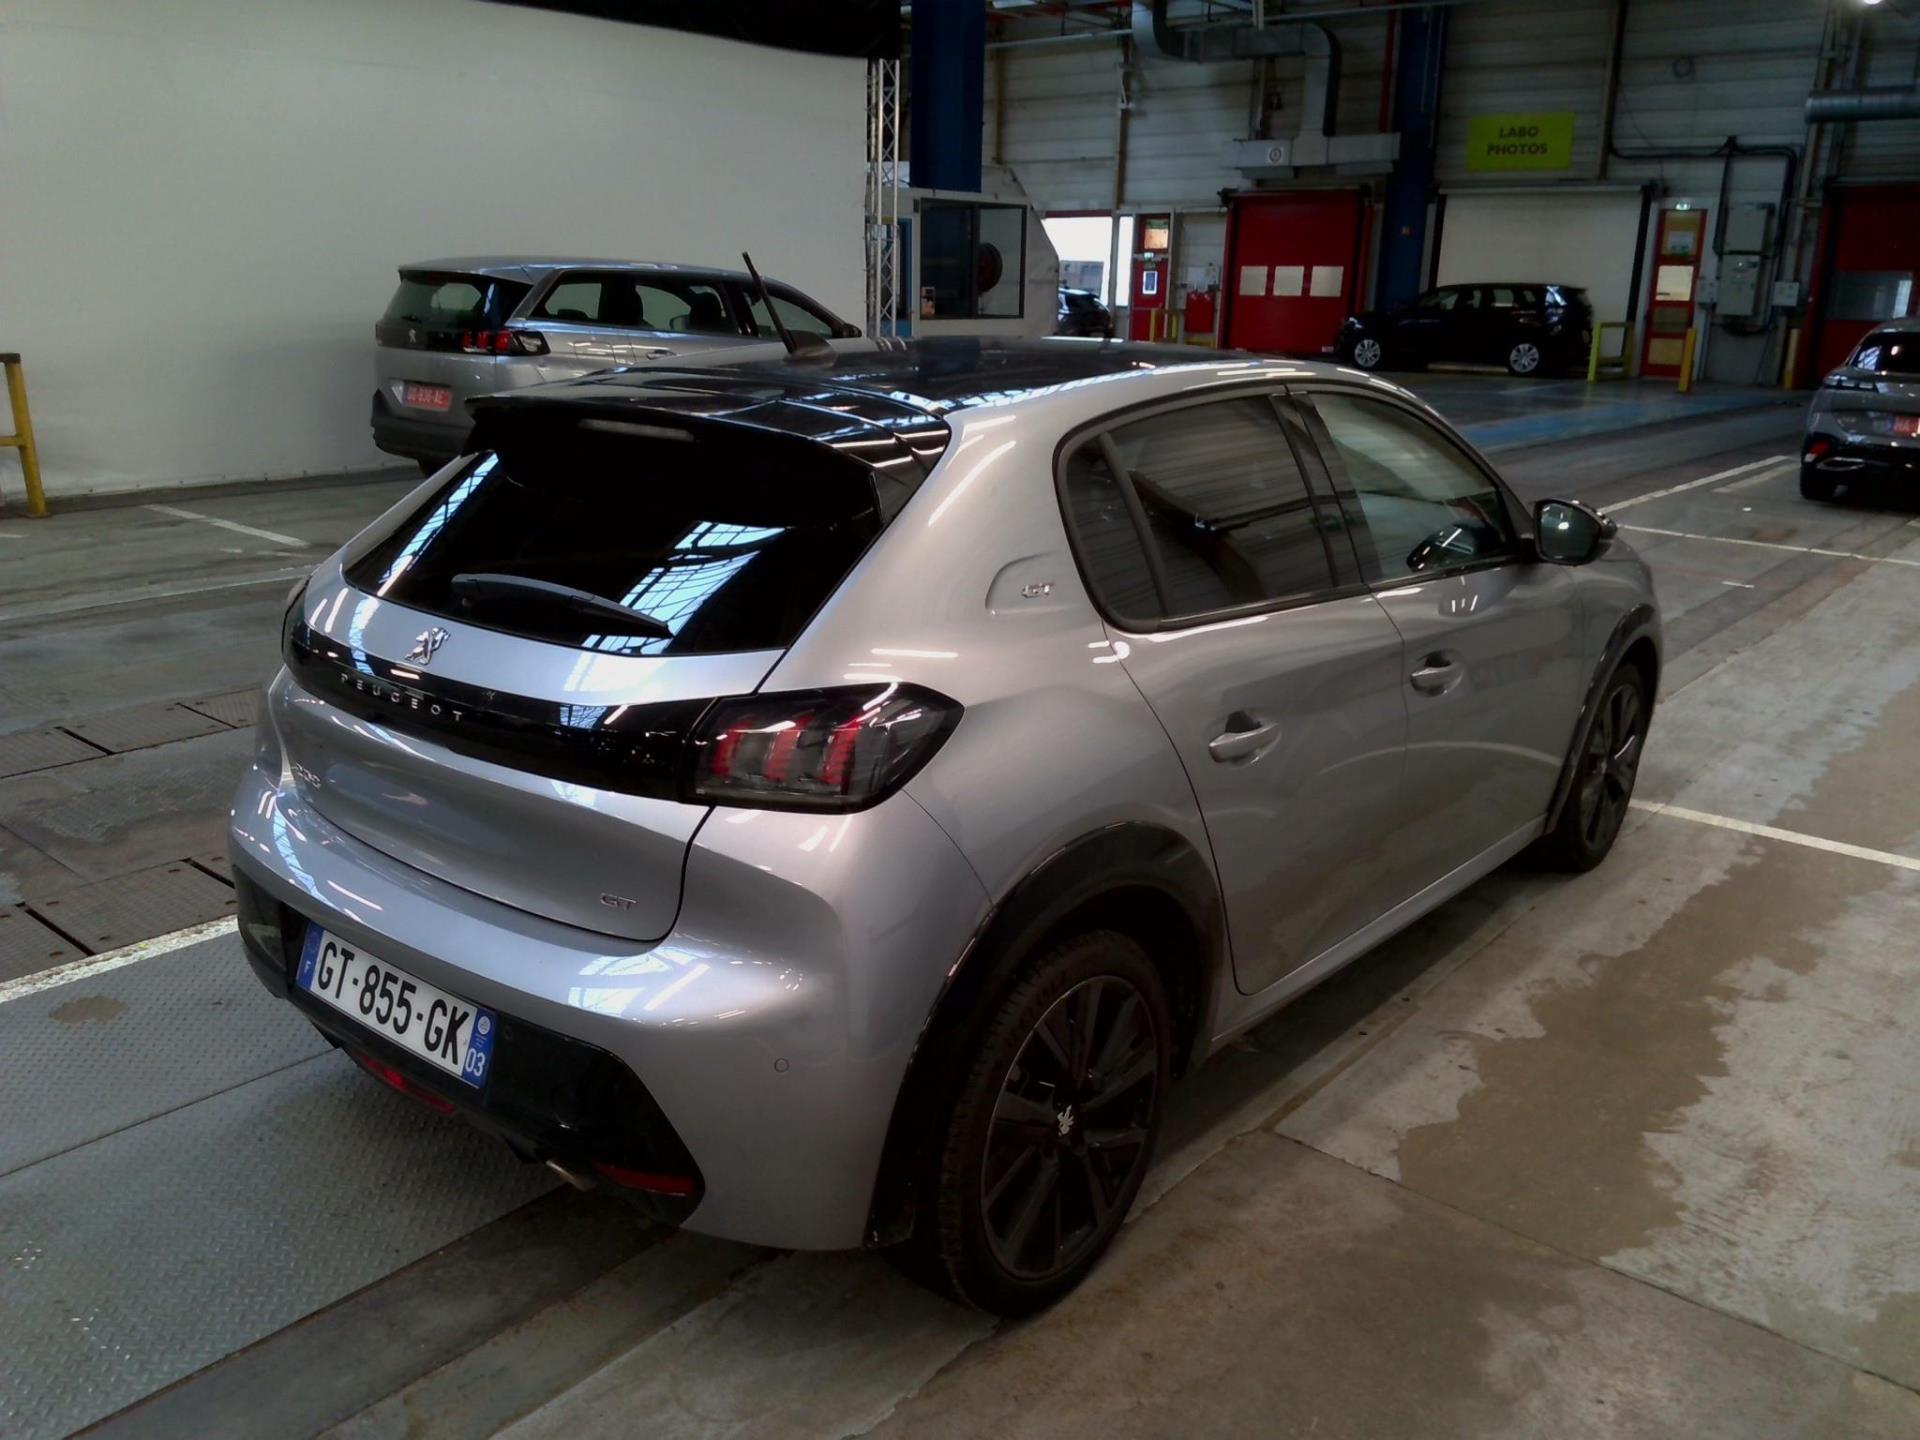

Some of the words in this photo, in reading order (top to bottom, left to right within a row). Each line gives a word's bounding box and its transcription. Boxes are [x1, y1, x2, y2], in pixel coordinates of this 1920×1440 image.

[1499, 126, 1540, 138] LABO
[1487, 142, 1548, 156] PHOTOS
[340, 673, 463, 721] PEUGEOT
[600, 892, 638, 911] GT
[317, 941, 470, 1066] GT-855-GK
[465, 1047, 487, 1077] 03
